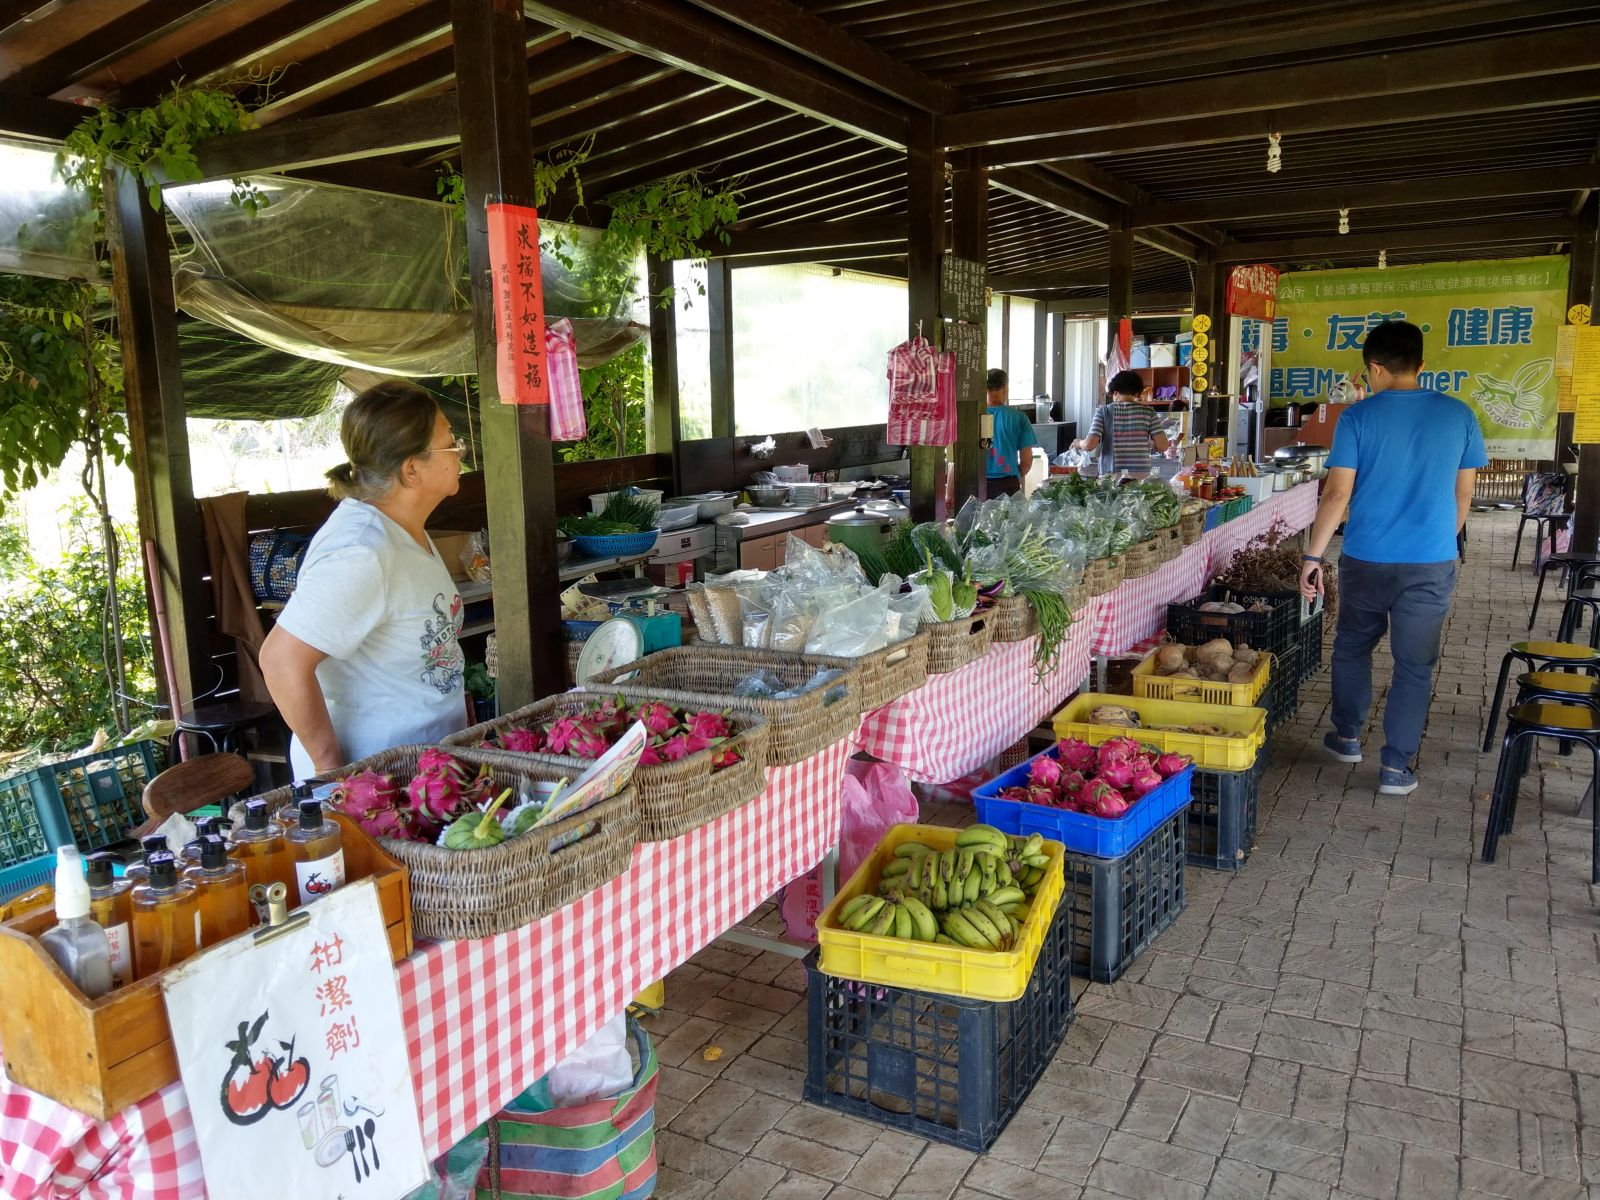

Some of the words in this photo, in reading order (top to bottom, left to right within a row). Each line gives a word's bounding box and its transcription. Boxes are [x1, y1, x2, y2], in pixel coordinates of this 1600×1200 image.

[516, 223, 541, 389] 求福不如造福
[1447, 306, 1534, 347] 健康
[1571, 305, 1589, 322] 冰
[310, 932, 360, 1060] 柑潔劑
